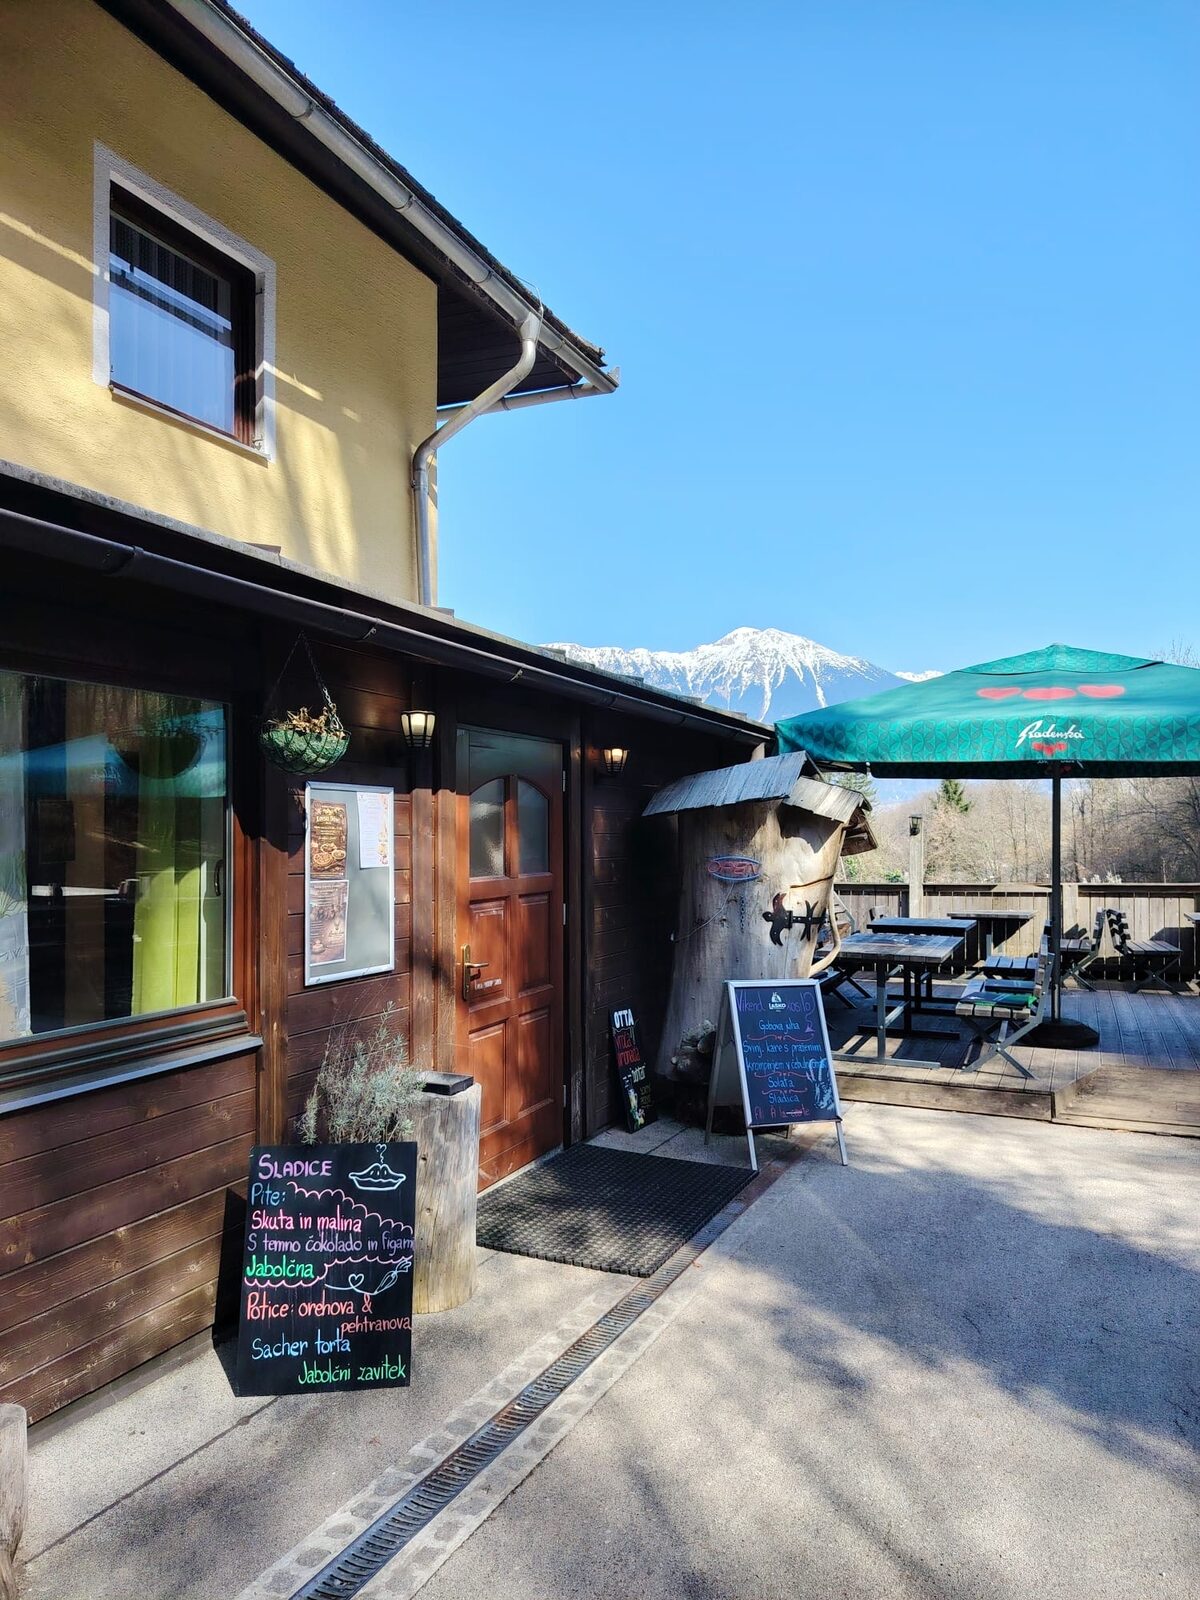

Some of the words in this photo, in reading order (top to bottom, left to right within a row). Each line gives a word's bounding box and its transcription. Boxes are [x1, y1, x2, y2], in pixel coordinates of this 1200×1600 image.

[1015, 720, 1084, 748] Radenska
[613, 1009, 634, 1028] OTTA
[768, 1077, 794, 1088] Solata
[769, 1094, 799, 1104] Sladica
[258, 1154, 333, 1179] SLADICE
[251, 1182, 286, 1206] Pite:
[251, 1210, 294, 1230] Skuta
[299, 1213, 312, 1229] in
[317, 1204, 362, 1233] malina
[263, 1235, 301, 1253] temno
[306, 1235, 362, 1253] čokolado
[368, 1237, 378, 1249] in
[246, 1255, 315, 1278] Jabolčna
[247, 1291, 295, 1320] Potice:
[298, 1290, 354, 1317] orehova
[362, 1293, 372, 1313] &
[341, 1315, 413, 1338] pehtranova
[252, 1332, 309, 1361] Sacher
[315, 1329, 351, 1356] torta
[298, 1359, 351, 1385] Jabolčni
[357, 1355, 406, 1381] zavitek
